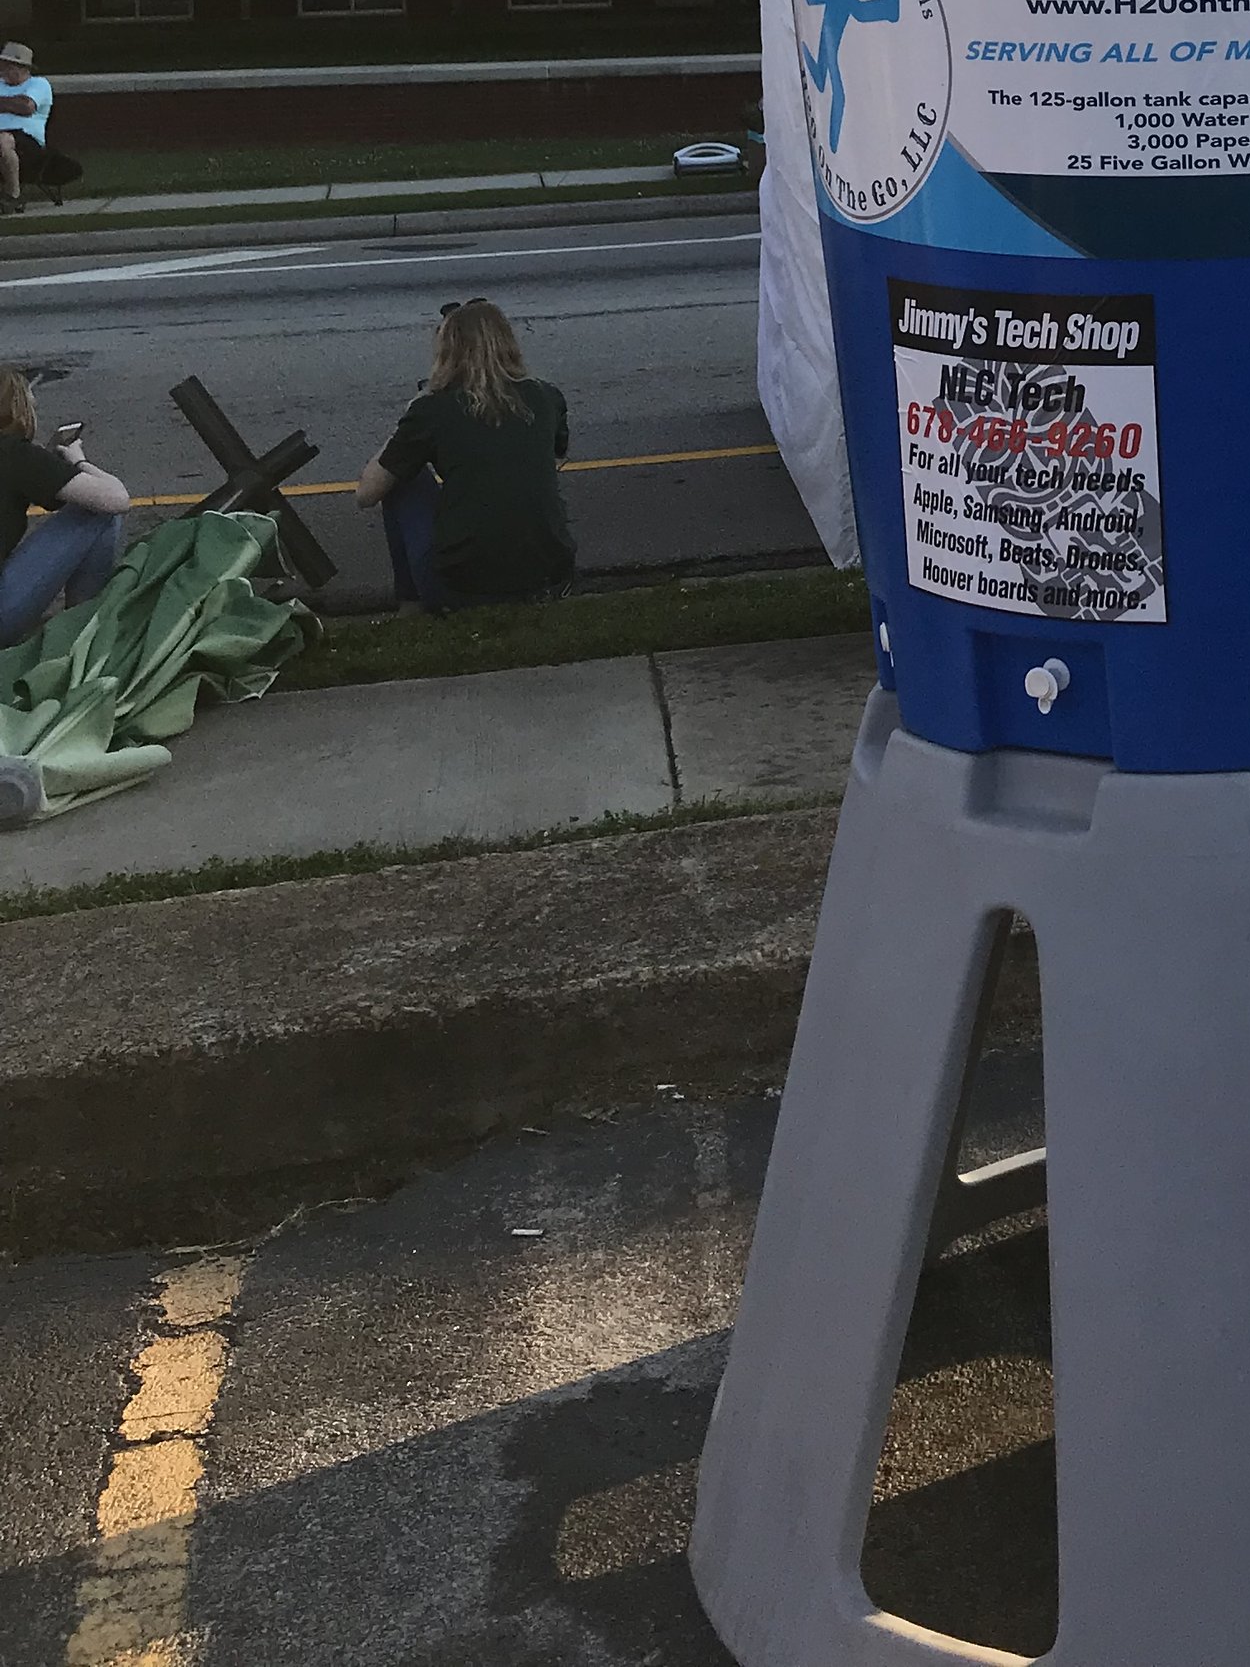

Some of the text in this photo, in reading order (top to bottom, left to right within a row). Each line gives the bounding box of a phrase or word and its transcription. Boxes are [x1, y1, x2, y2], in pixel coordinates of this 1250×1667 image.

[965, 40, 1093, 63] SERVING
[1099, 42, 1158, 63] ALL
[1169, 40, 1217, 63] OF
[987, 89, 1022, 106] The
[1029, 91, 1136, 111] 125-gallon
[1143, 91, 1191, 107] tank
[1114, 113, 1175, 130] 1,000
[1181, 112, 1249, 127] Water
[835, 173, 867, 211] The
[901, 102, 937, 172] LLC
[1067, 154, 1092, 170] 25
[1100, 154, 1144, 170] Five
[1150, 153, 1221, 170] Gallon
[1127, 133, 1188, 151] 3,000
[898, 298, 1140, 359] Jimmy's Tech Shop
[939, 364, 1085, 413] NLC Tech
[908, 443, 1146, 493] For all your tech needs
[913, 483, 1144, 537] Apple, Samsung, Android,
[916, 519, 1146, 575] Microsoft, Beats, Drones,
[922, 556, 1147, 610] Hoover boards and more.
